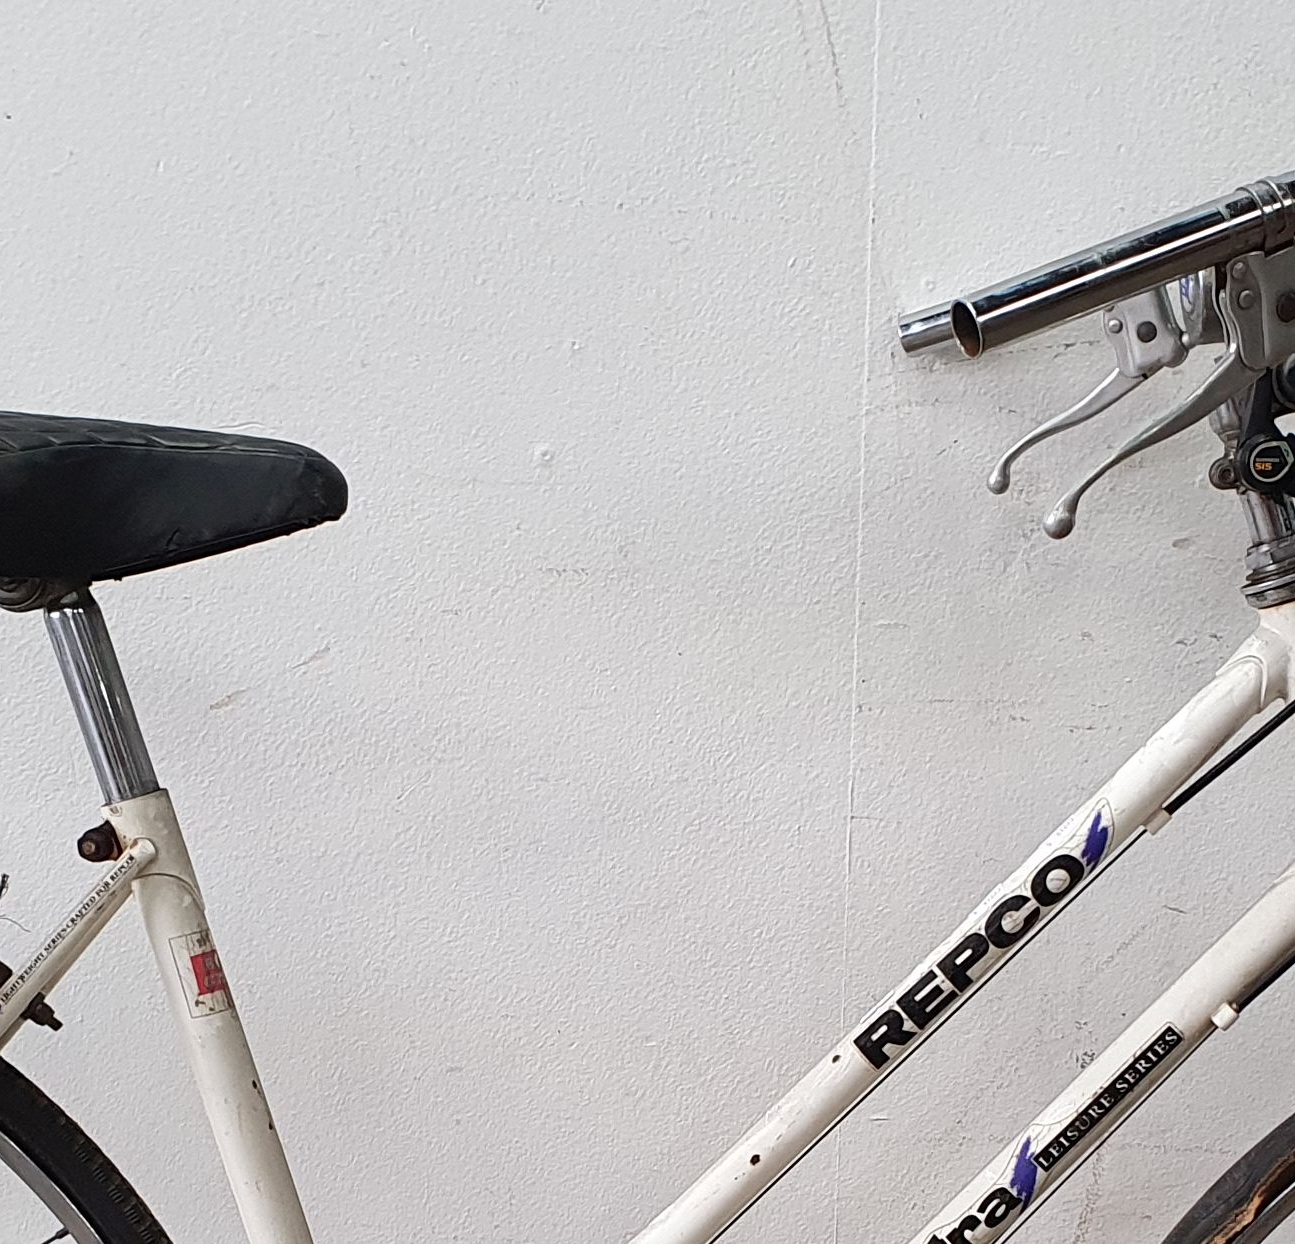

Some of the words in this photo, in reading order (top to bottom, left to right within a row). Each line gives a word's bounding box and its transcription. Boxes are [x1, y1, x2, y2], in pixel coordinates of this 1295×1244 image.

[853, 853, 1086, 1070] REPCO
[1038, 1094, 1114, 1167] LEISURE
[1115, 1031, 1177, 1093] SERIES
